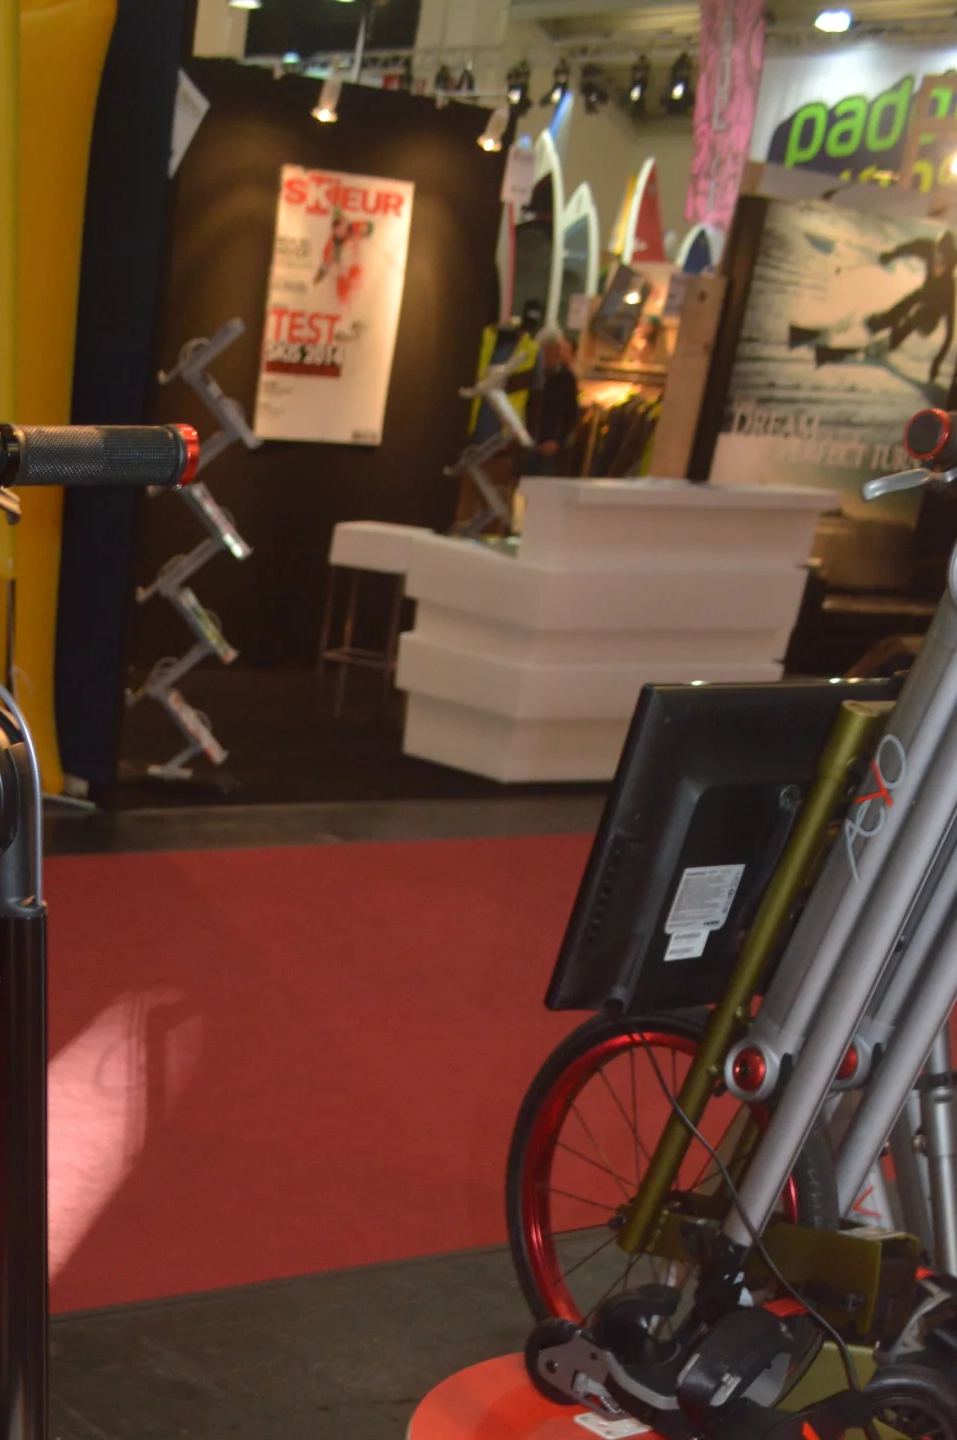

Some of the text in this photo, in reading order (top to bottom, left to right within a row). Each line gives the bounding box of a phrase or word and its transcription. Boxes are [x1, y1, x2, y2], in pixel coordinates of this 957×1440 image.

[284, 170, 405, 219] SKIEUR
[269, 307, 342, 346] TEST
[731, 410, 822, 439] DREAM
